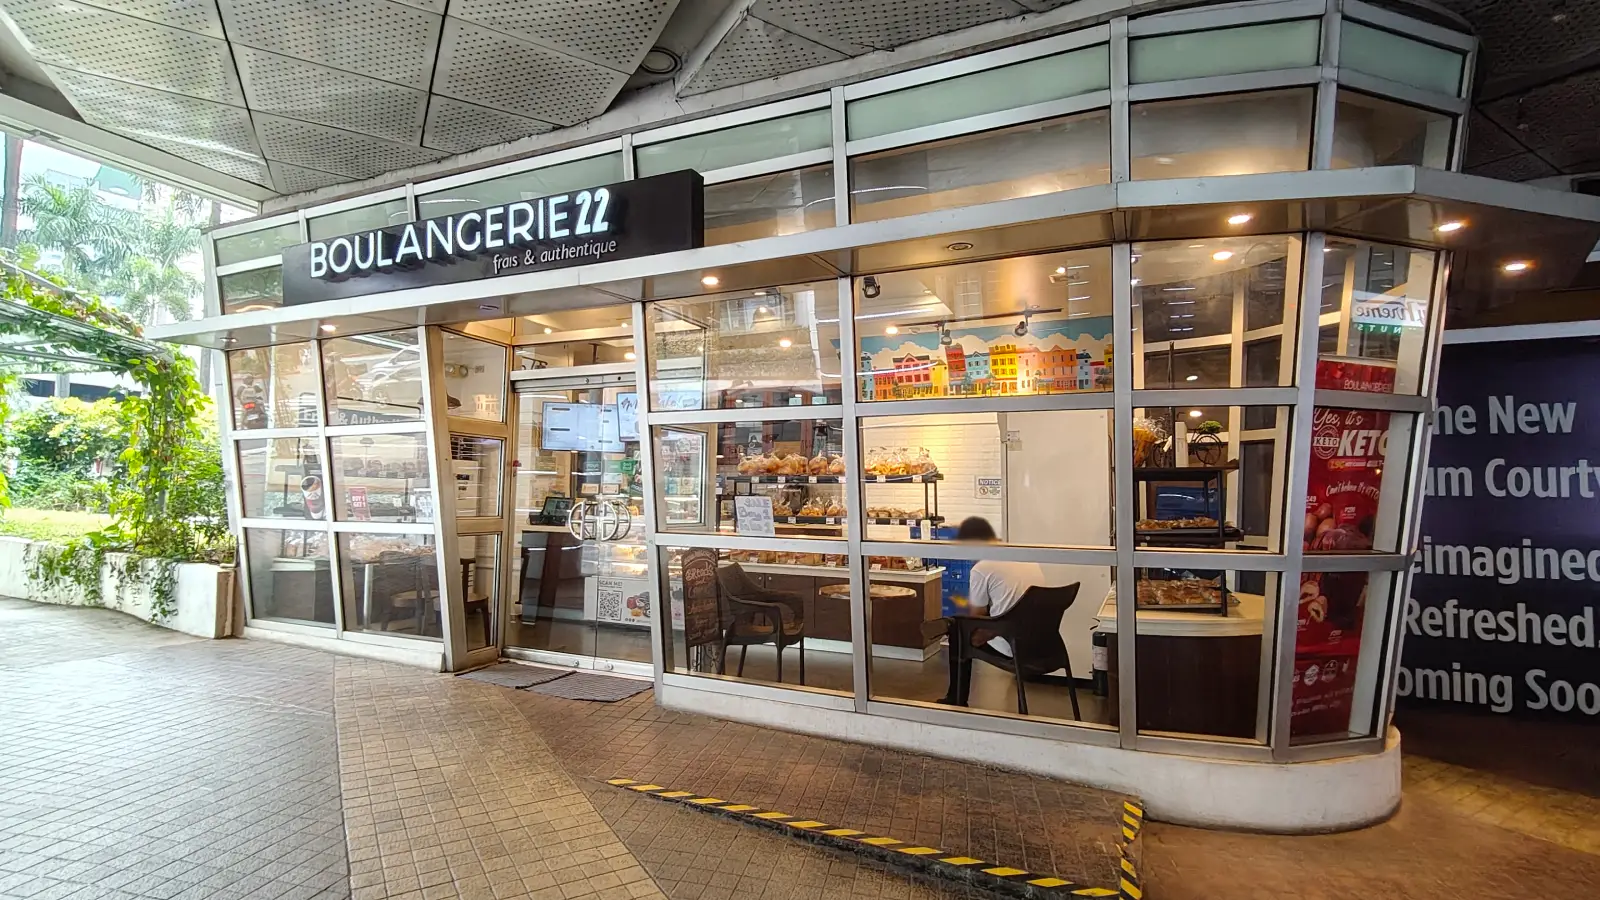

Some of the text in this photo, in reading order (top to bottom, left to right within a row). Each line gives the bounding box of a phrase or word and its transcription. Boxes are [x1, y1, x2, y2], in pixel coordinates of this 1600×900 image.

[493, 238, 618, 275] frais & authentique
[1488, 395, 1577, 435] New
[1315, 438, 1338, 446] KETO
[1405, 598, 1600, 648] Refreshed
[1396, 662, 1513, 714] oming
[1525, 669, 1600, 715] Soo
